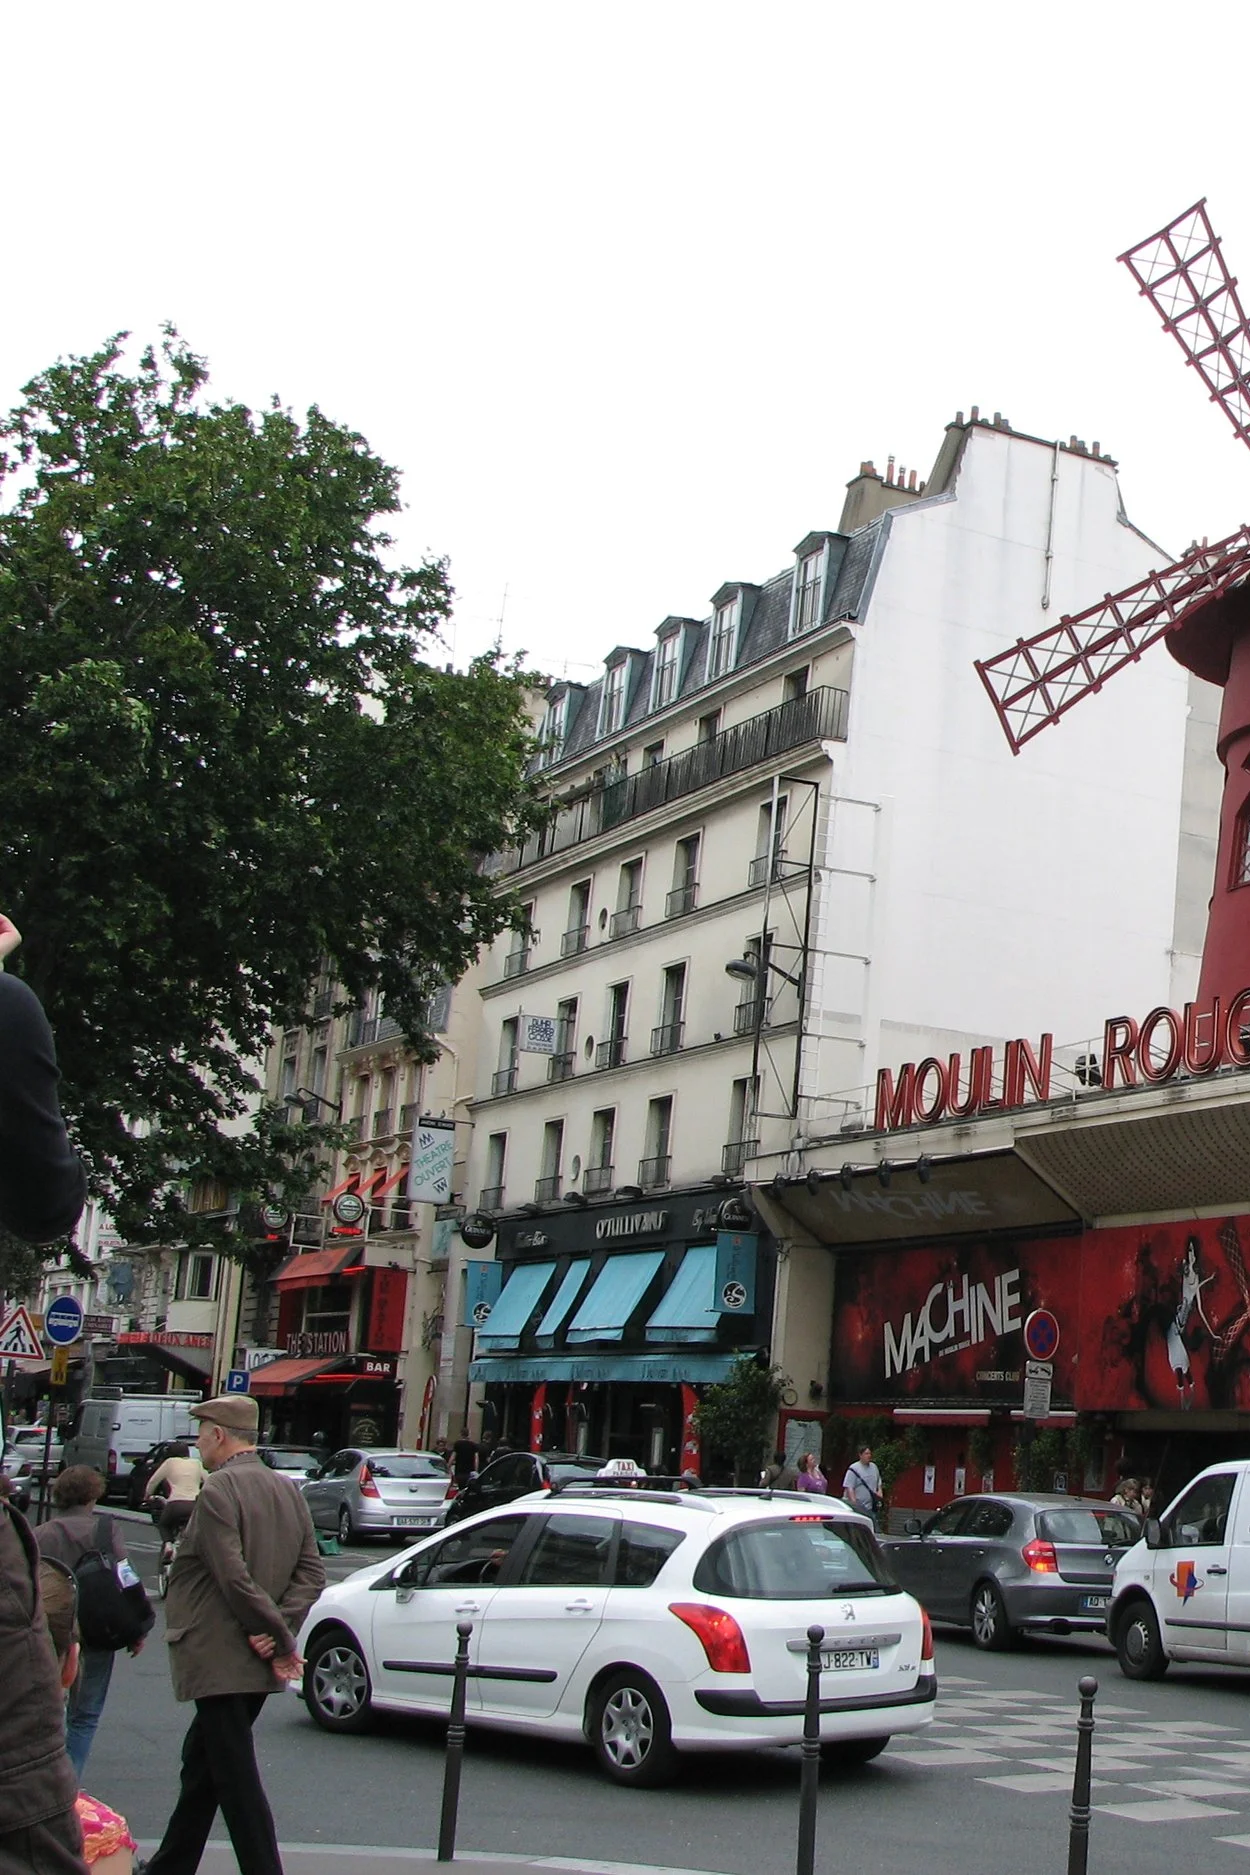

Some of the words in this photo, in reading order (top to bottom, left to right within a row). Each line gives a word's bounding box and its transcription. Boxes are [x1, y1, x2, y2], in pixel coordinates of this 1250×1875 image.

[874, 1032, 1053, 1134] MOULIN
[414, 1140, 453, 1168] THEATRE
[414, 1157, 451, 1186] OUVERT
[884, 1268, 1021, 1378] MACHINE
[287, 1334, 302, 1352] THE
[307, 1332, 346, 1353] STATION
[366, 1362, 391, 1372] BAR
[617, 1462, 634, 1471] TAXI
[823, 1651, 872, 1669] J-822-TV
